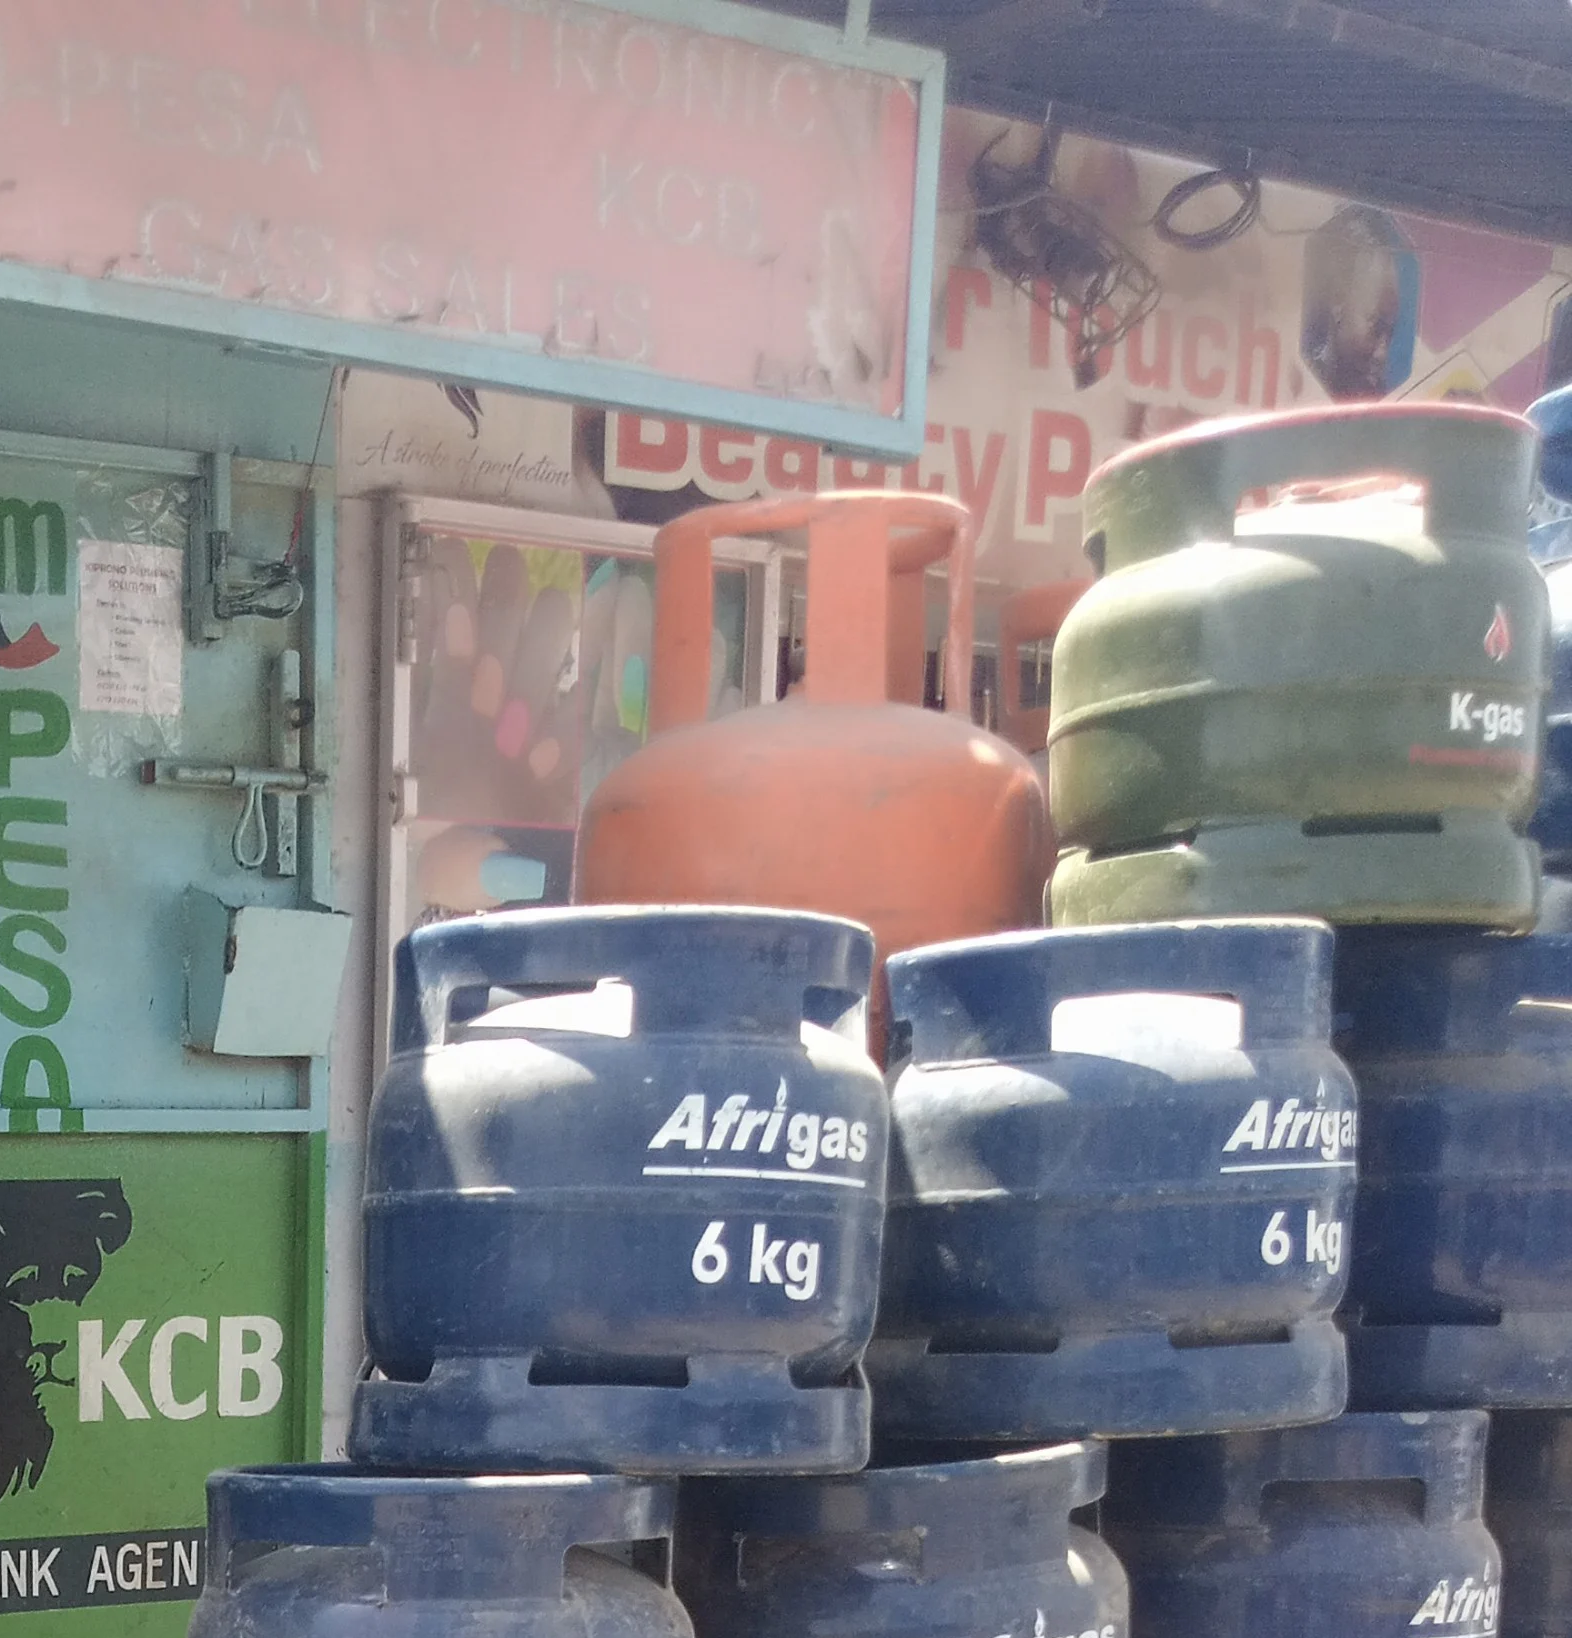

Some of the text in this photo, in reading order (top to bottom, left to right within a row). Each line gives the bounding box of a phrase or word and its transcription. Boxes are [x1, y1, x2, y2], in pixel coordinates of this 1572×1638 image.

[1449, 691, 1526, 742] K-gas
[647, 1078, 867, 1170] Afrigas
[691, 1220, 820, 1301] 6 kg
[1261, 1209, 1343, 1275] 6 kg
[77, 1315, 284, 1424] KCB
[86, 1539, 198, 1595] AGEN
